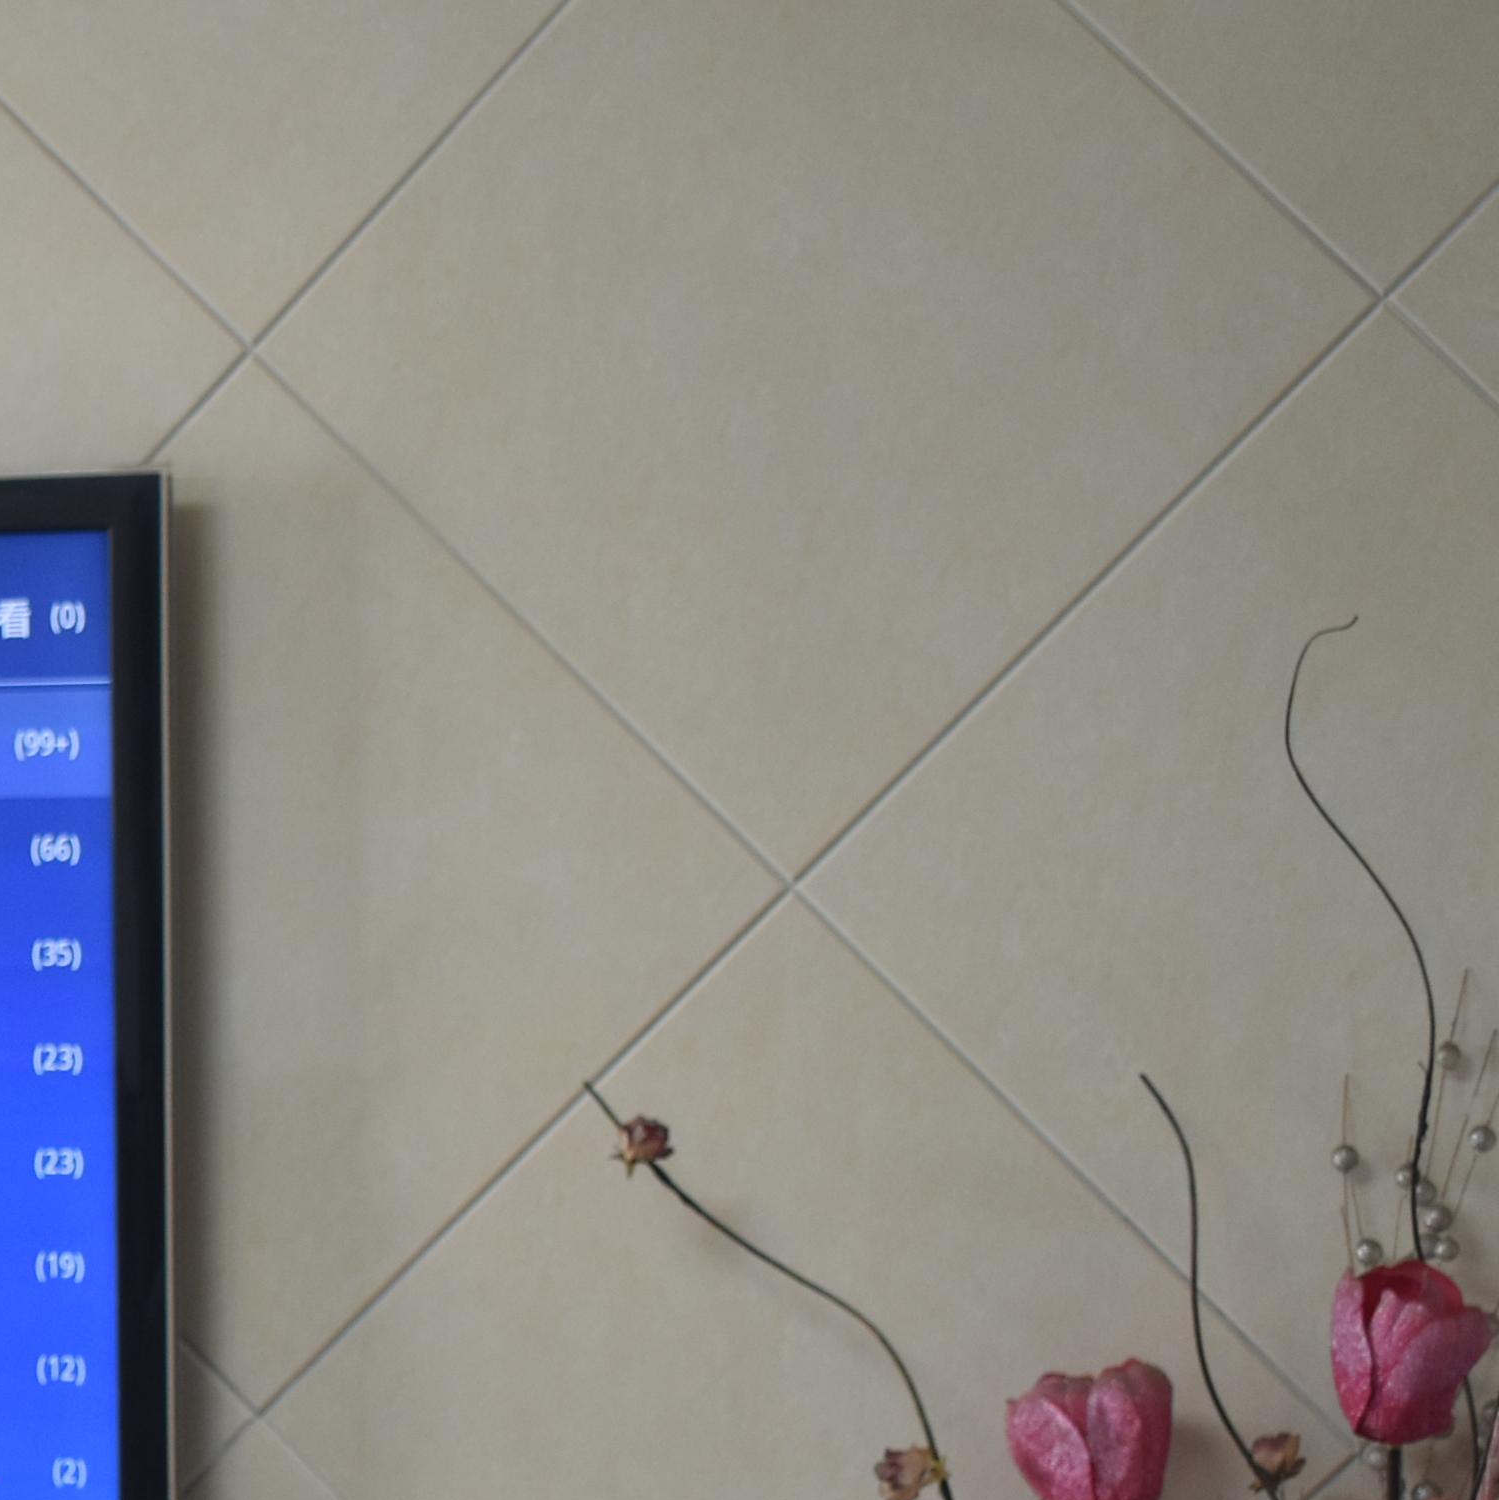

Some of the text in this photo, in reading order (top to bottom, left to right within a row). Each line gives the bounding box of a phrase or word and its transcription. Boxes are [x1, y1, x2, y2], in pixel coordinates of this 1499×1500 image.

[49, 602, 85, 634] (0)
[14, 729, 80, 761] (99+)
[30, 834, 81, 866] (66)
[32, 939, 82, 971] (35)
[33, 1043, 83, 1076] (23)
[34, 1148, 84, 1179] (23)
[35, 1251, 85, 1283] (19)
[36, 1354, 86, 1386] (12)
[53, 1457, 87, 1489] (2)
